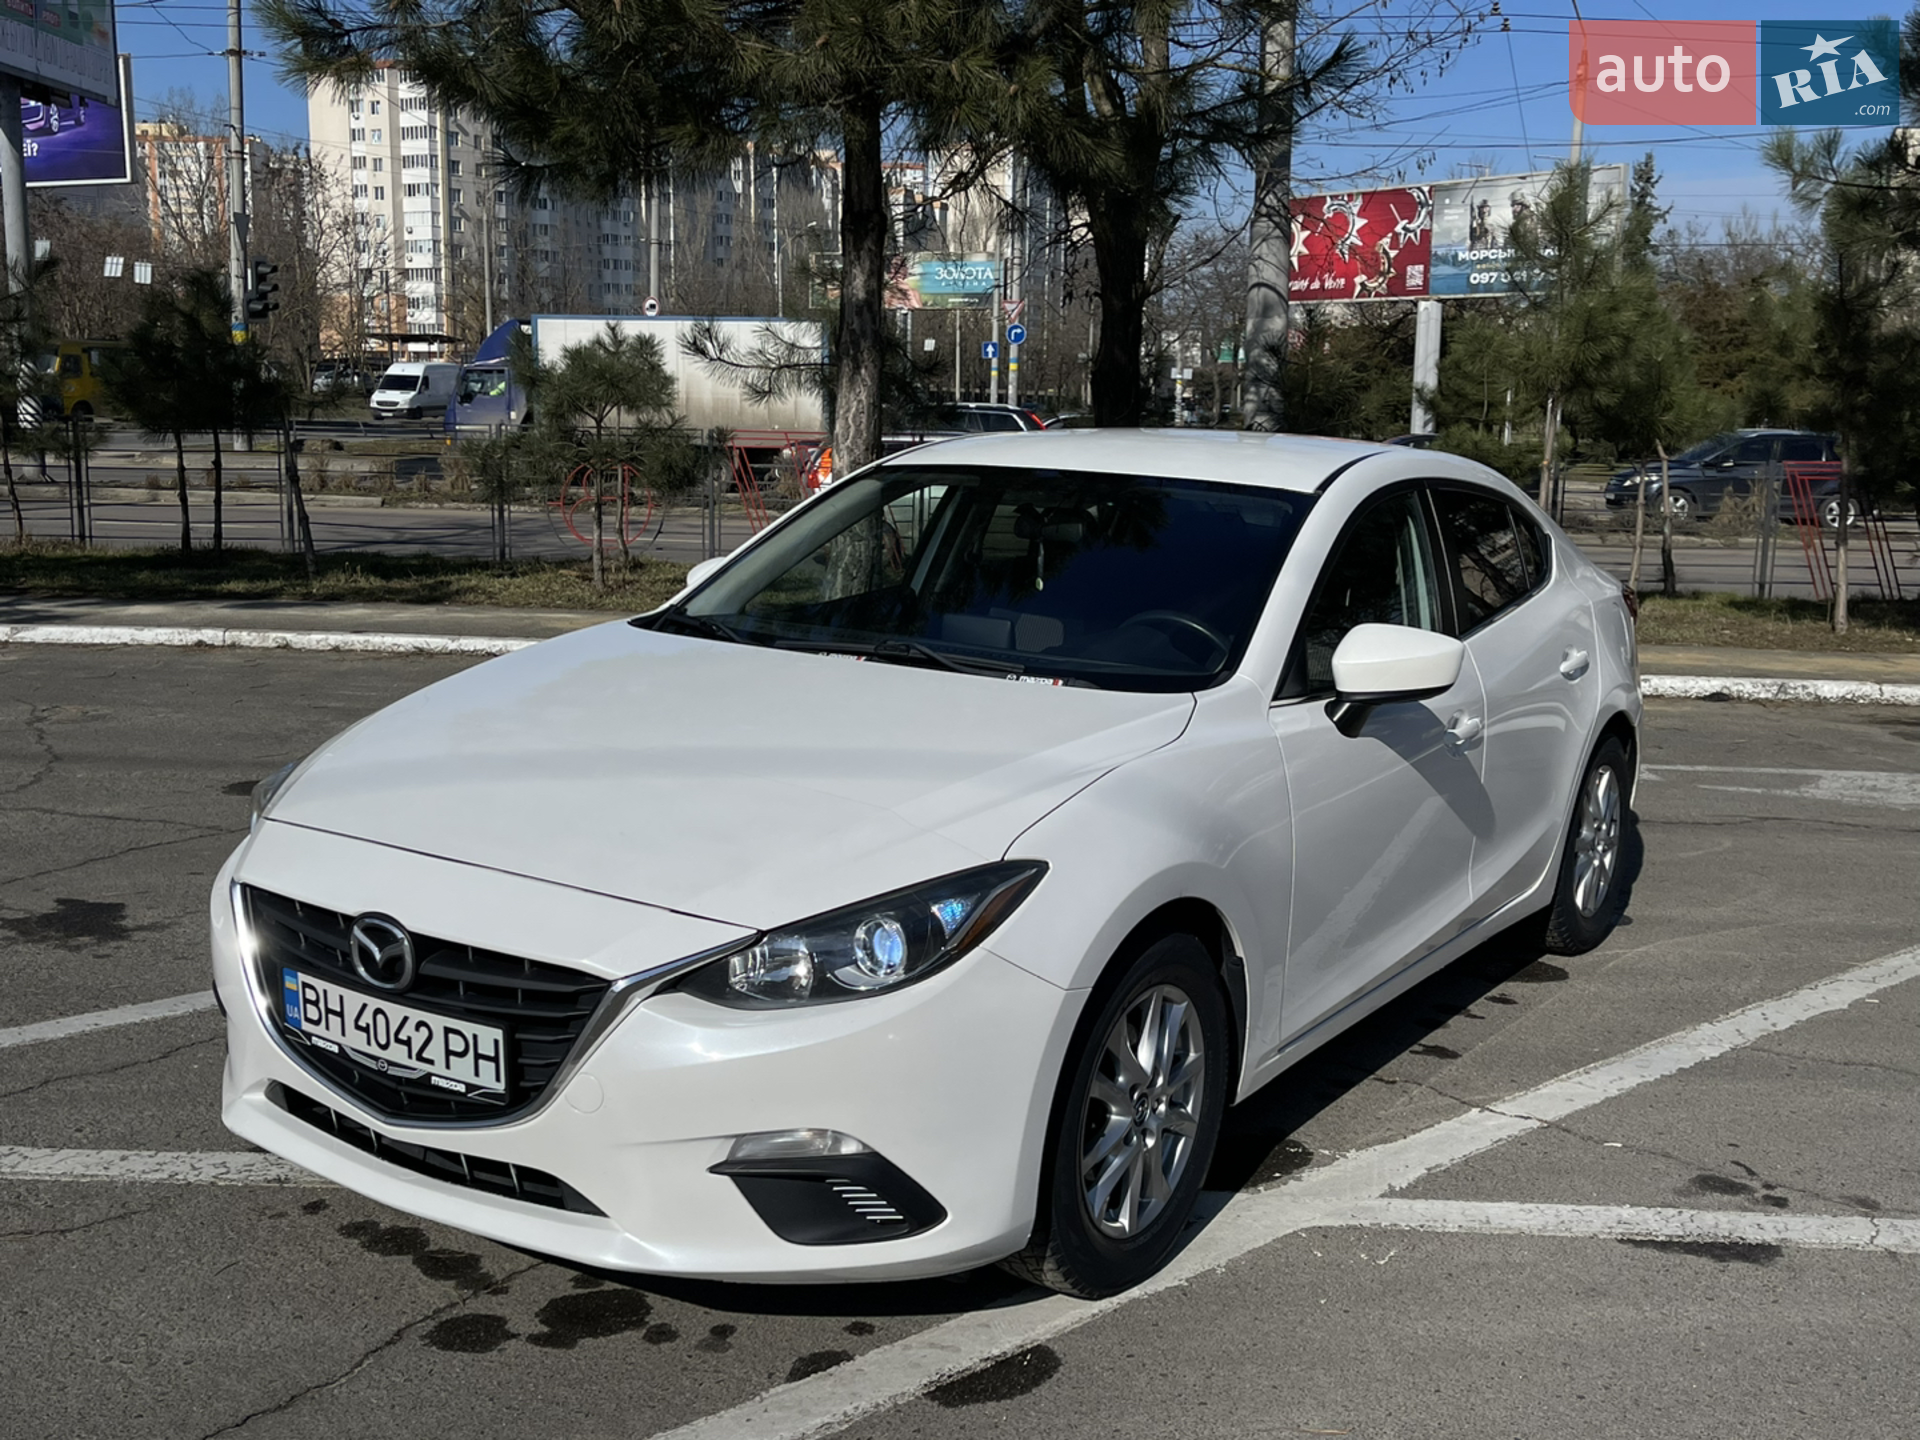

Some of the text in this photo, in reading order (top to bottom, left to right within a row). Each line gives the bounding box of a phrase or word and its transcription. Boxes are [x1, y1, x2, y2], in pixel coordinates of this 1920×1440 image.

[934, 266, 994, 280] ЗОЛОТА
[1469, 271, 1498, 285] 097
[286, 1003, 300, 1019] UA
[301, 981, 502, 1084] BH 4042 PH
